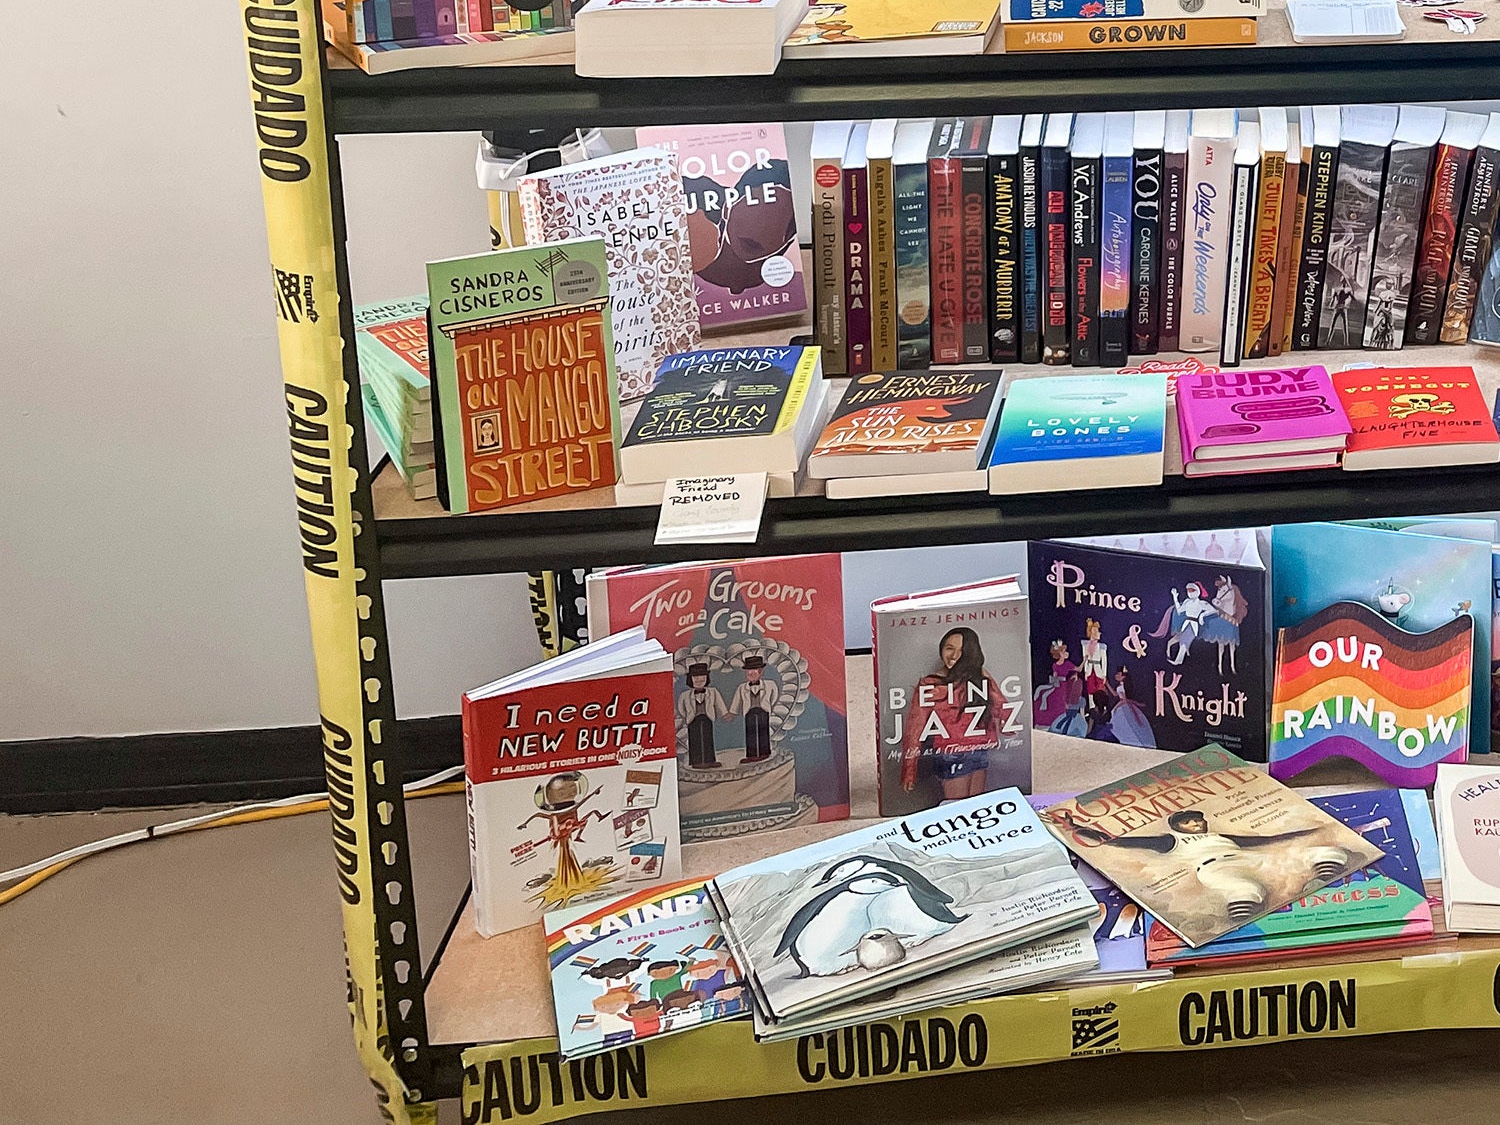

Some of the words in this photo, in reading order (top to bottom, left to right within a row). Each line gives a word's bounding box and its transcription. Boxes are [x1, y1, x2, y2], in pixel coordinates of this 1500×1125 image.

[1089, 24, 1186, 44] GROWN
[1315, 152, 1332, 209] STEPHEN
[1310, 213, 1328, 244] KING
[450, 270, 529, 292] SANDRA
[439, 286, 543, 316] CISNEROS
[456, 340, 506, 382] THE
[512, 318, 603, 373] HOUSE
[1191, 368, 1313, 388] JUDY
[1192, 381, 1318, 399] BLUME
[468, 381, 499, 409] ON
[508, 361, 607, 449] MANGO
[1027, 414, 1141, 426] LOVELY
[1030, 426, 1132, 437] BONES
[283, 381, 339, 579] CAUTION
[470, 437, 611, 505] STREET
[669, 492, 740, 505] REMOVED
[630, 579, 692, 627] Two
[709, 571, 816, 609] Grooms
[1046, 560, 1142, 612] Prince
[709, 606, 783, 639] Cake
[1308, 636, 1384, 671] OUR
[889, 676, 1022, 711] BEING
[1154, 671, 1248, 726] Knight
[506, 705, 521, 729] I
[535, 696, 619, 725] need
[631, 699, 649, 716] a
[886, 702, 1024, 744] JAZZ
[1284, 695, 1457, 758] RAINBOW
[500, 731, 569, 759] NEW
[578, 723, 657, 751] BUTT!
[899, 797, 1019, 842] tango
[967, 822, 1034, 852] three
[1179, 978, 1356, 1046] CAUTION
[796, 1014, 989, 1084] CUIDADO
